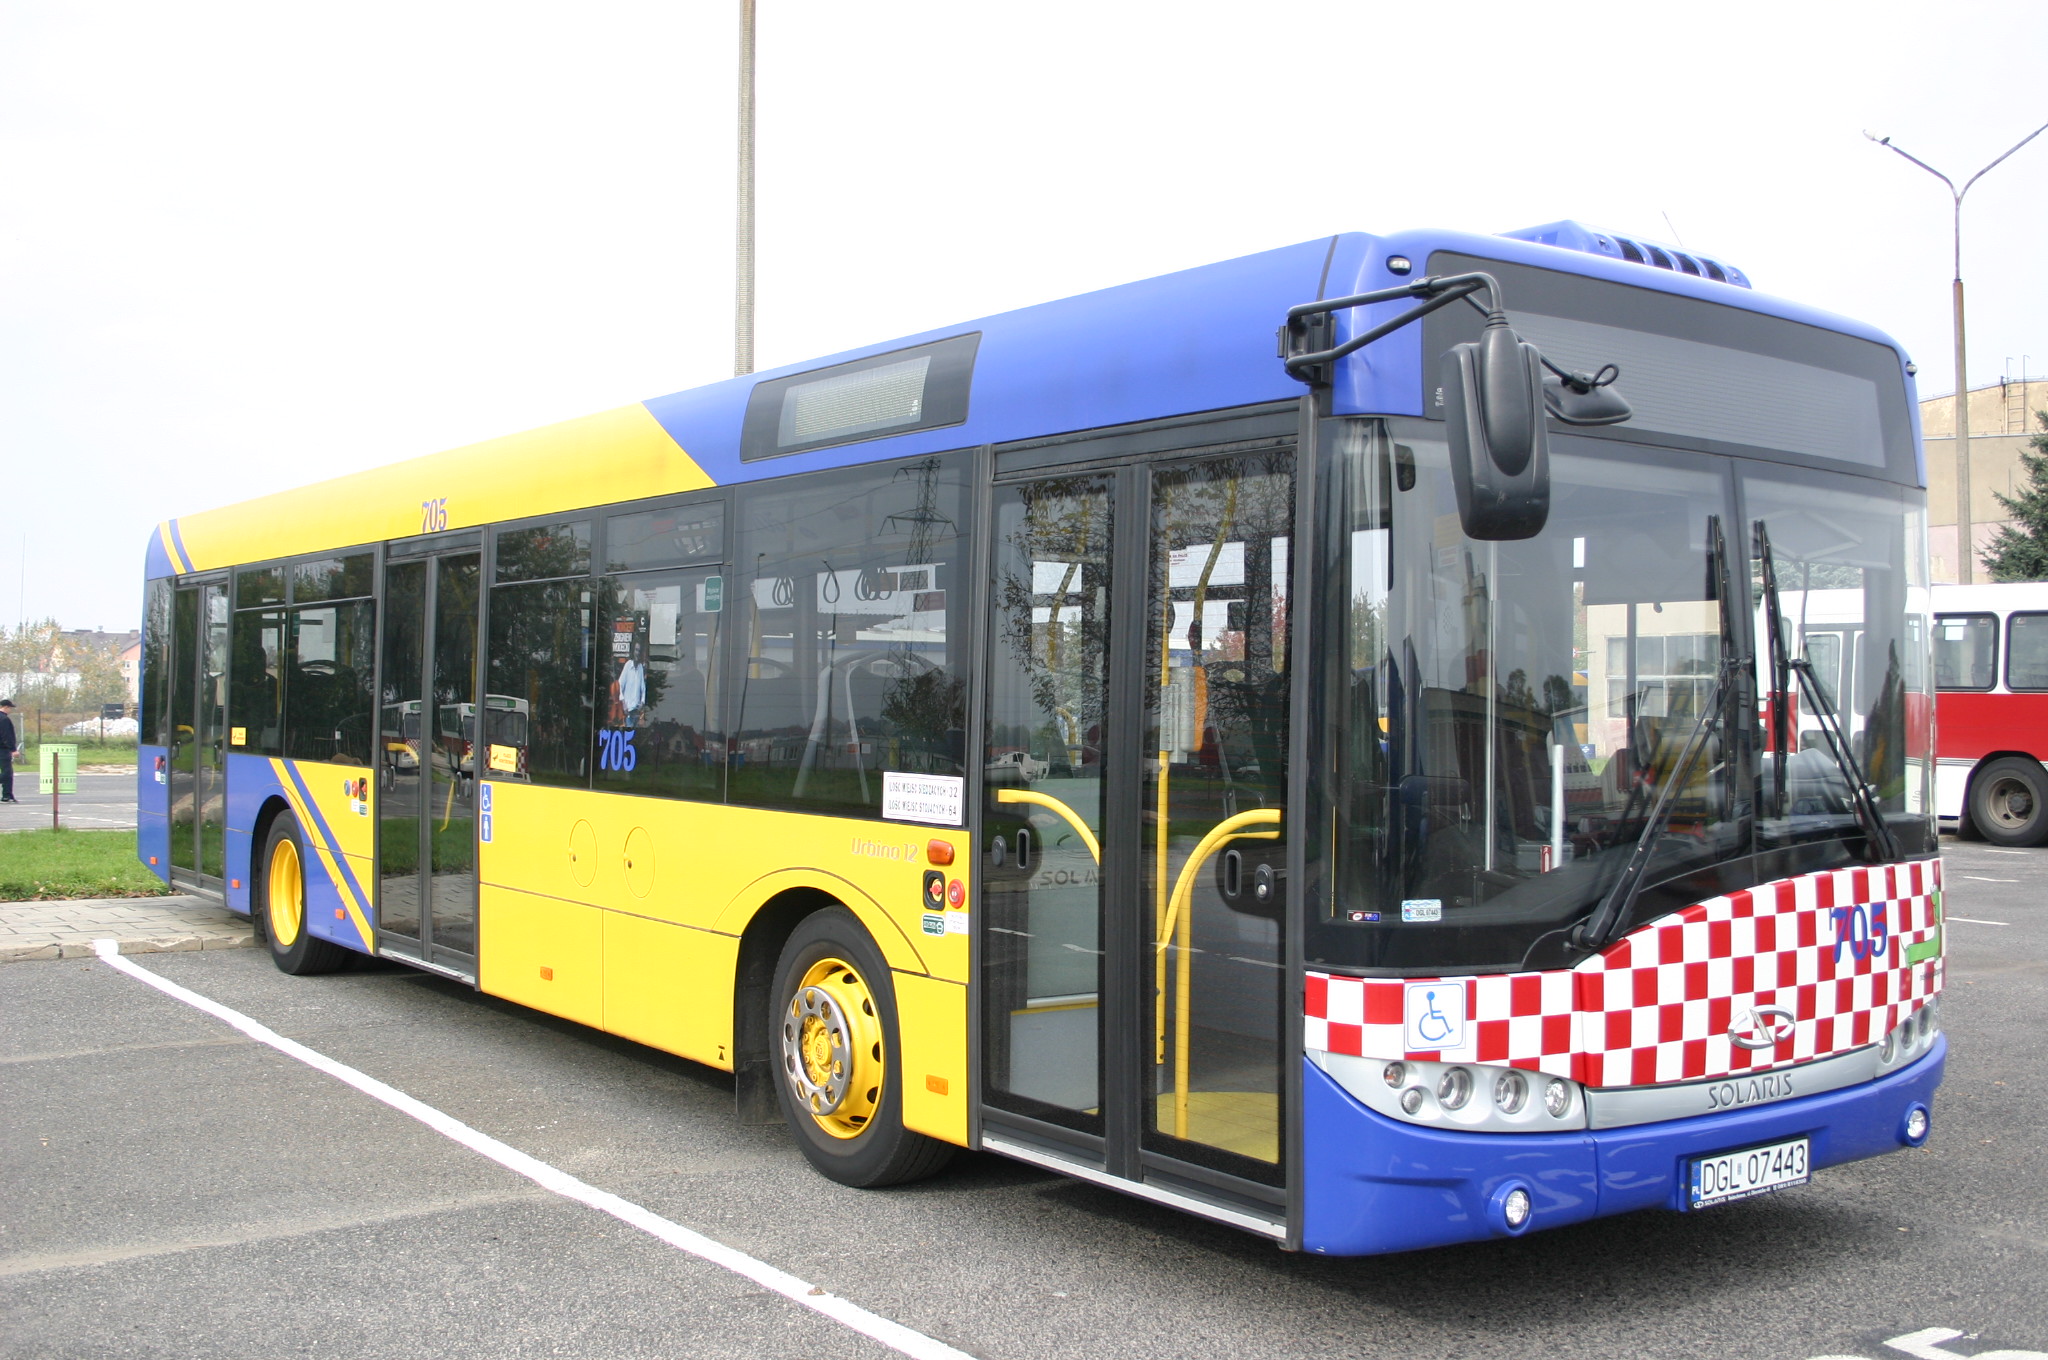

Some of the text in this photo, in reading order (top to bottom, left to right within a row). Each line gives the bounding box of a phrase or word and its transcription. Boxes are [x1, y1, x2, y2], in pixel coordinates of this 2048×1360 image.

[421, 496, 448, 534] 705
[599, 729, 636, 772] 705
[949, 786, 958, 798] 32
[949, 804, 957, 816] 64
[851, 837, 919, 863] Urbino 12
[1828, 901, 1888, 964] 705
[1707, 1072, 1793, 1110] SOLARIS
[1703, 1143, 1806, 1196] DGL 07443
[1692, 1185, 1700, 1196] PL
